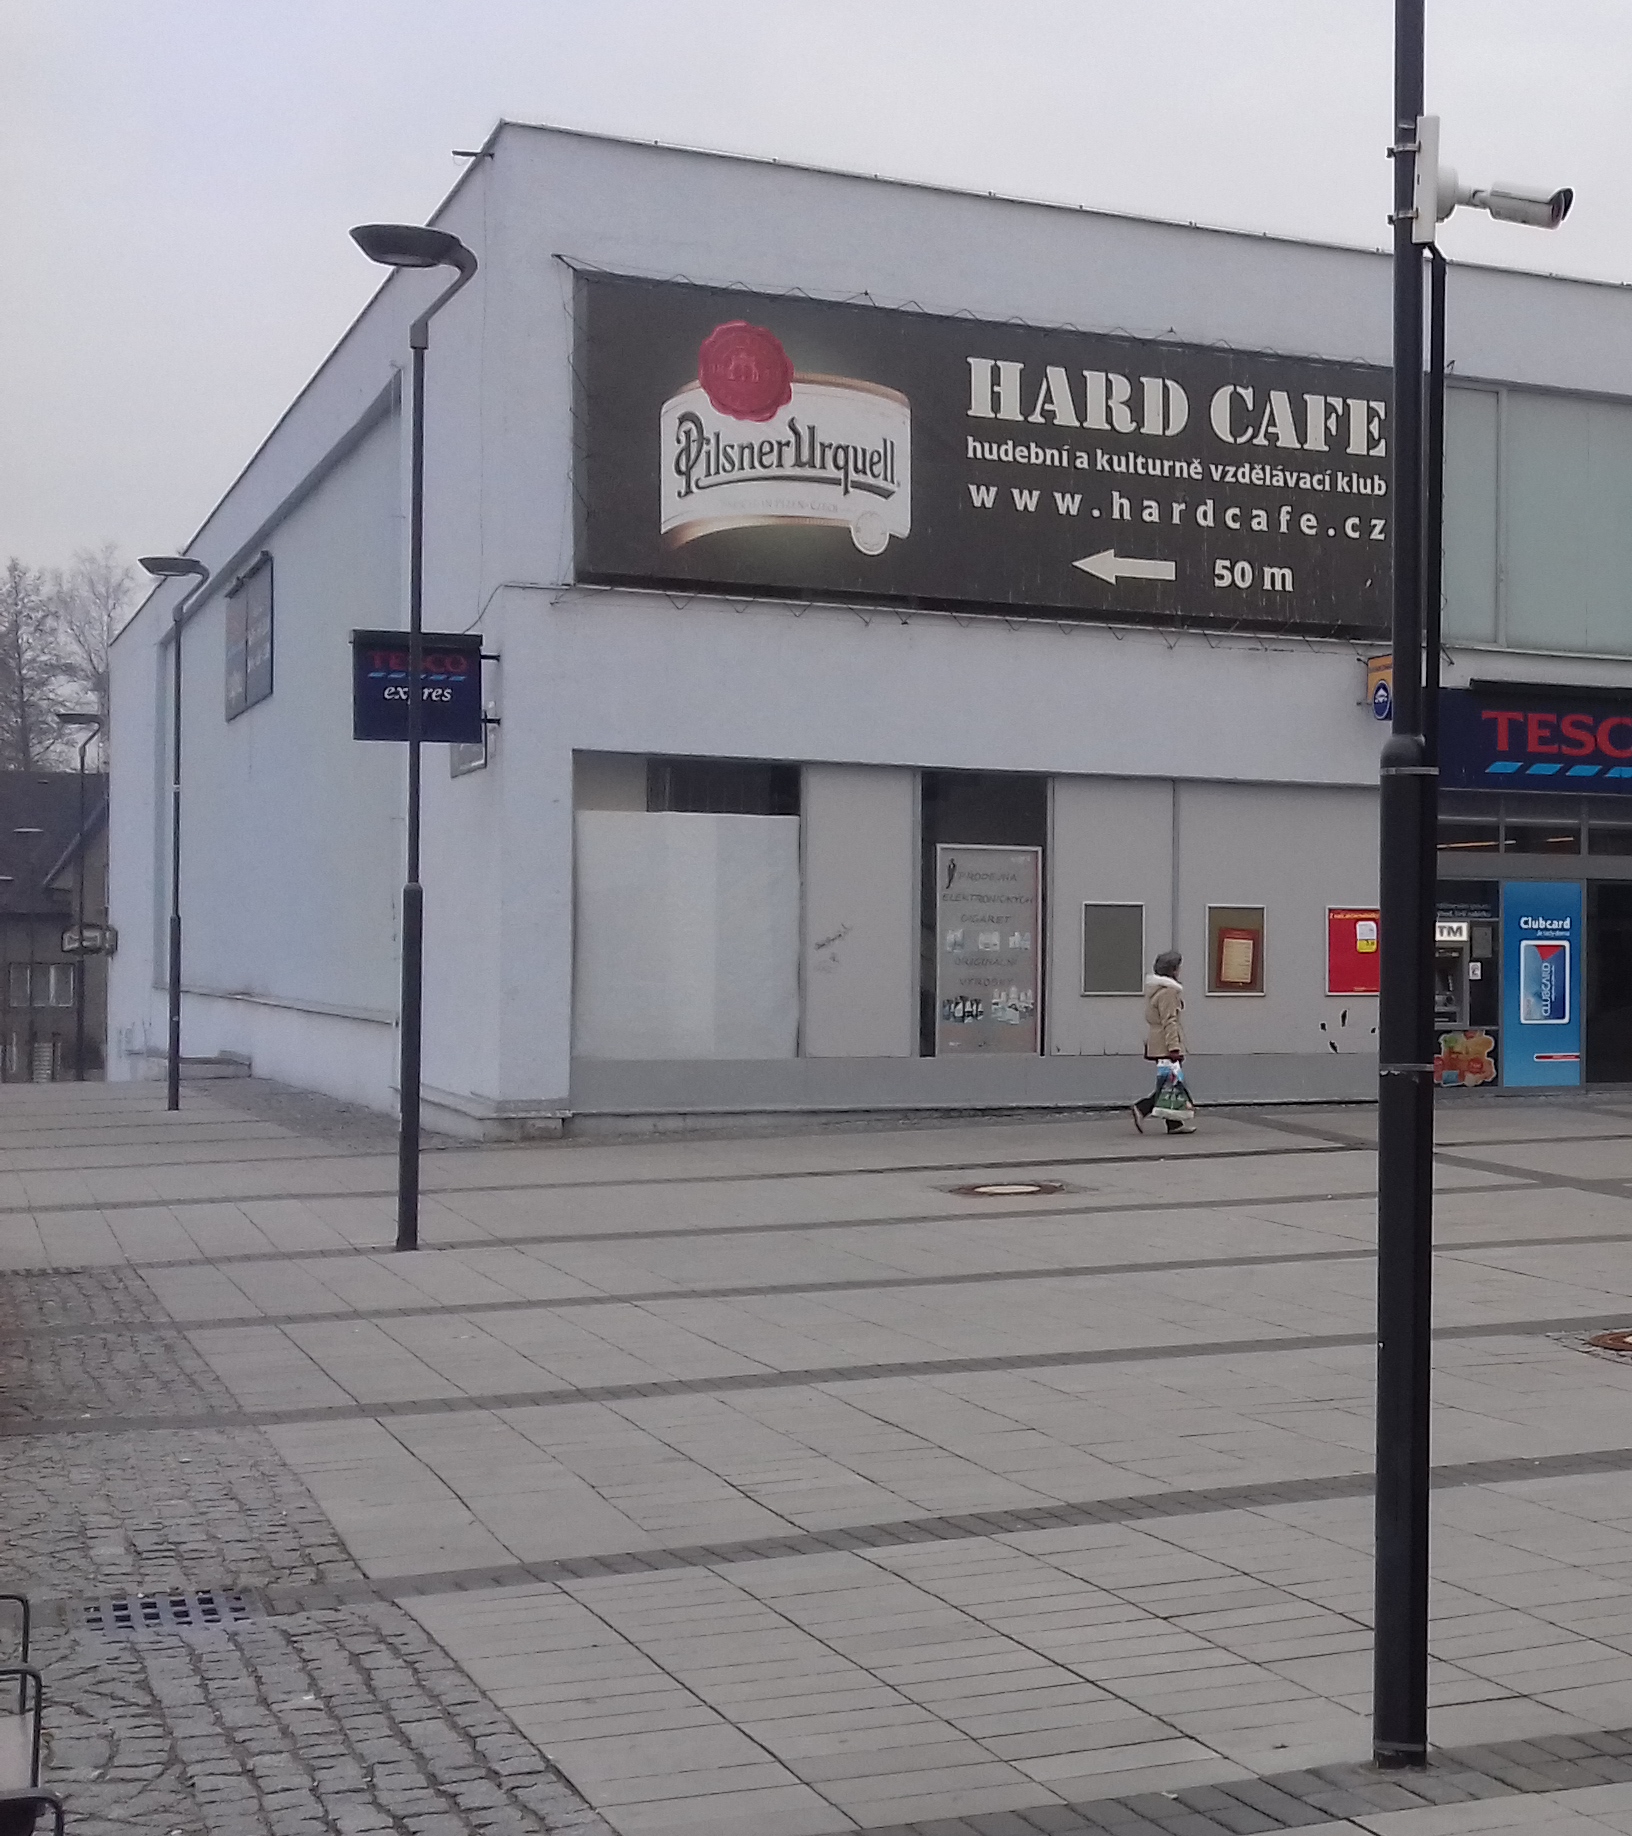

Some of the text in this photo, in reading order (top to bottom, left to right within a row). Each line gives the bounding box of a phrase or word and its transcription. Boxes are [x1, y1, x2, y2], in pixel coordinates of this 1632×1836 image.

[966, 356, 1387, 457] HARD CAFE
[674, 410, 898, 499] Pilsner Urquell
[966, 435, 1388, 497] hudební a kulturně vzdělávací klub
[968, 483, 1387, 541] www.hardcafe.cz
[1214, 557, 1294, 593] 50 m
[368, 651, 468, 673] TECO
[384, 685, 453, 705] exres
[1437, 926, 1463, 938] TM
[1519, 916, 1571, 929] Clubcard
